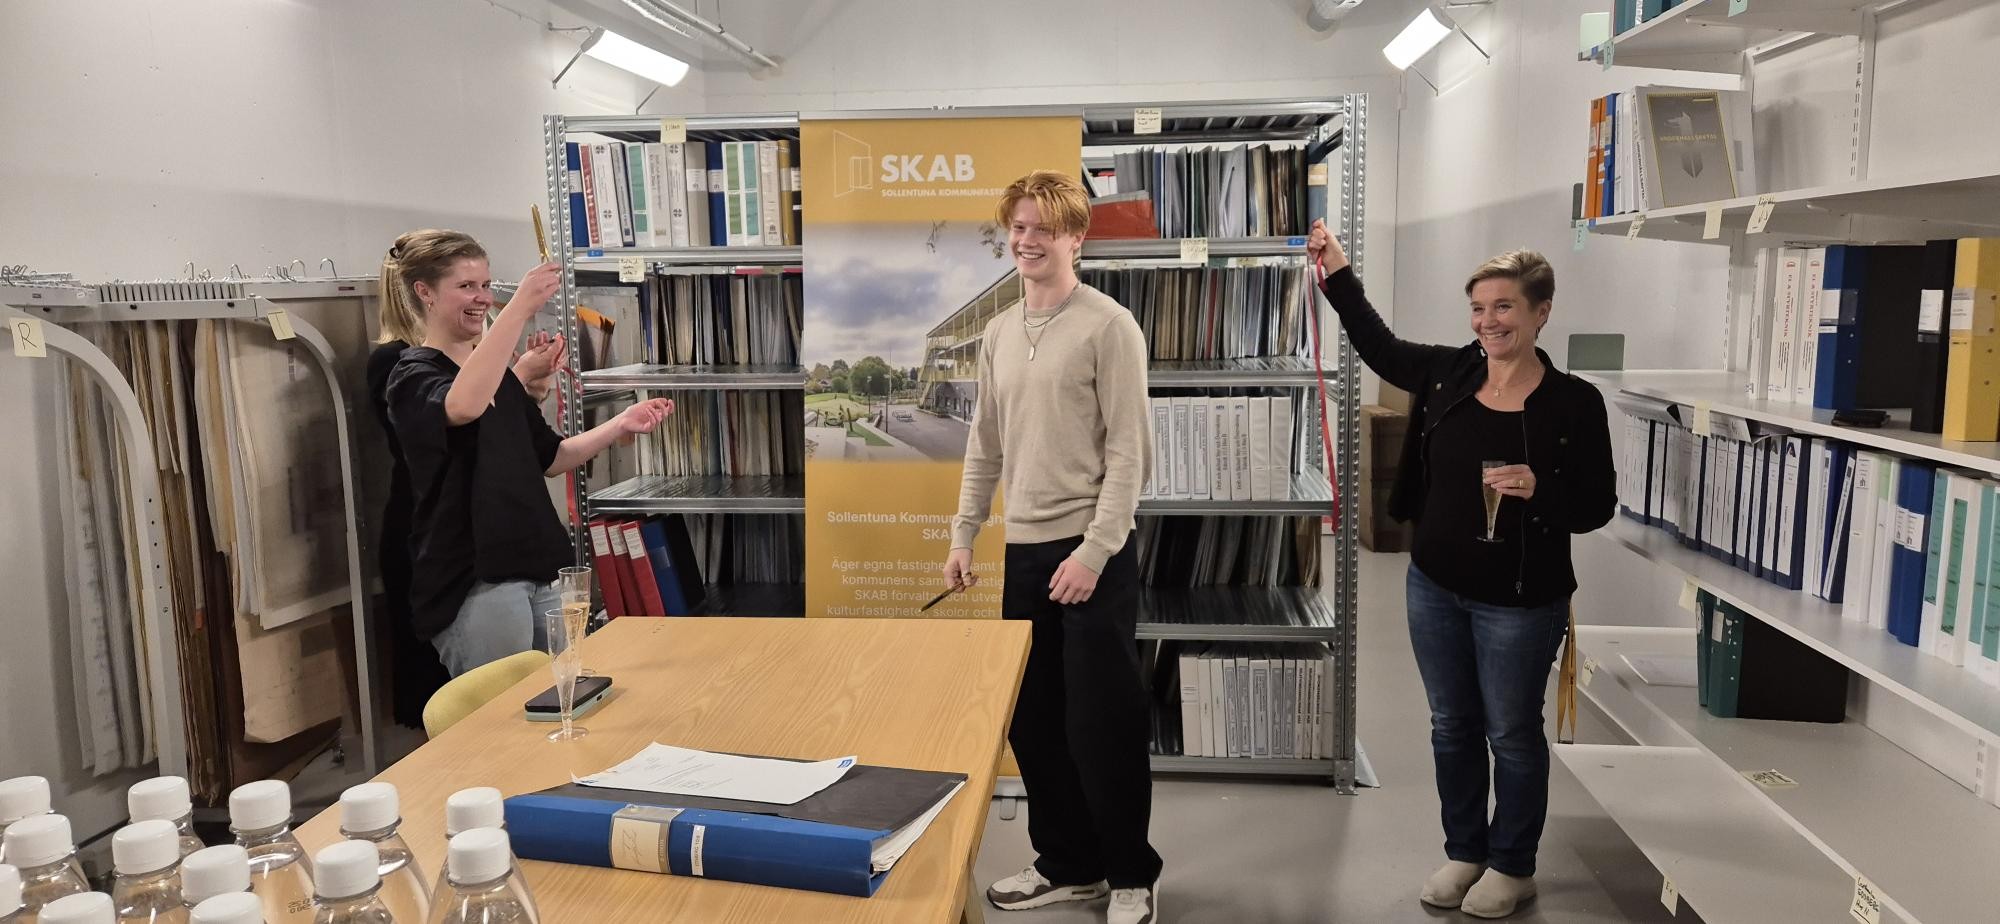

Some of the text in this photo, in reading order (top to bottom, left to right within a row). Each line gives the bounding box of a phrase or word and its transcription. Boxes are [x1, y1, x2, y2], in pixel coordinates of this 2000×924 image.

[881, 154, 976, 183] SKAB
[882, 188, 936, 197] SOLLENTUNA
[18, 322, 39, 350] R
[827, 511, 896, 524] Sollentuna
[922, 528, 952, 540] SKA
[832, 556, 858, 572] Äger
[863, 560, 893, 573] egna
[897, 559, 945, 573] fastighe
[970, 561, 997, 571] amt
[842, 575, 914, 586] kommunens
[855, 590, 888, 600] SKAB
[891, 589, 936, 601] förvalta
[933, 606, 968, 617] skolor
[974, 606, 996, 617] och
